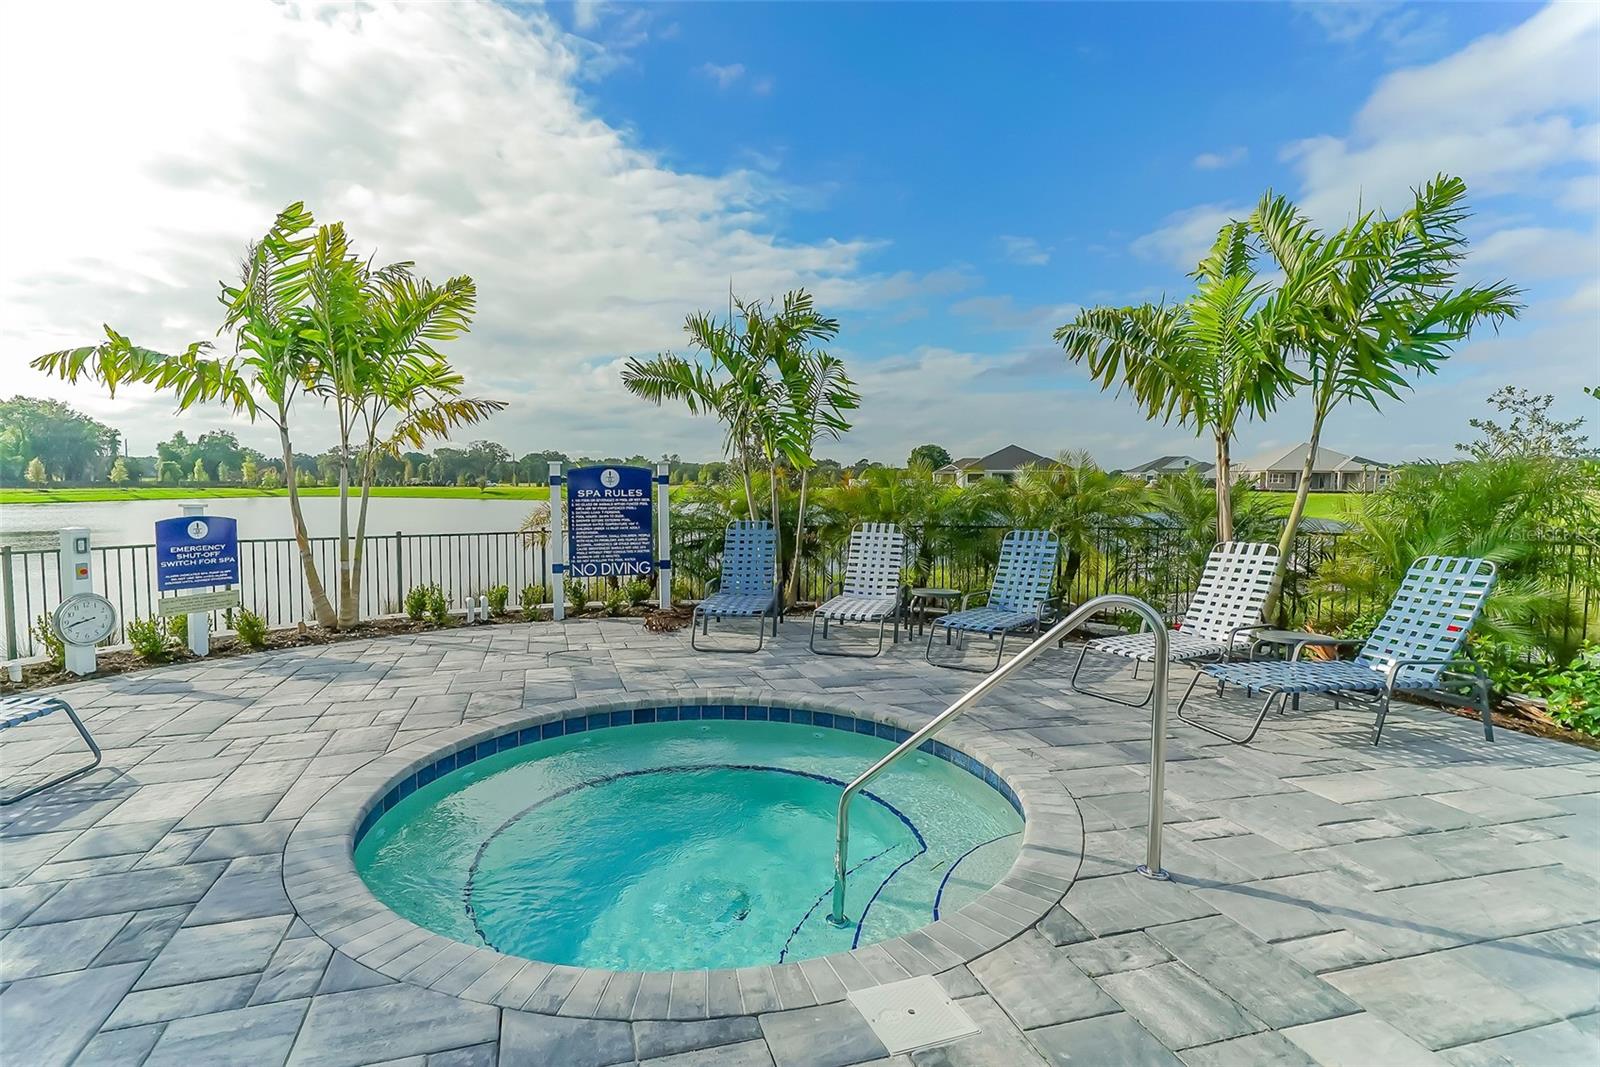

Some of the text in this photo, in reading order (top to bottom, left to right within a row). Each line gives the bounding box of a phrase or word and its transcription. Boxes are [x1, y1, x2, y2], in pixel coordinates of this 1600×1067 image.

[577, 489, 643, 498] SPA RULES
[170, 544, 226, 553] EMERGENCY
[176, 551, 221, 560] SHUT-OFF
[160, 560, 197, 568] SWITCH
[572, 561, 651, 576] NO DIVING
